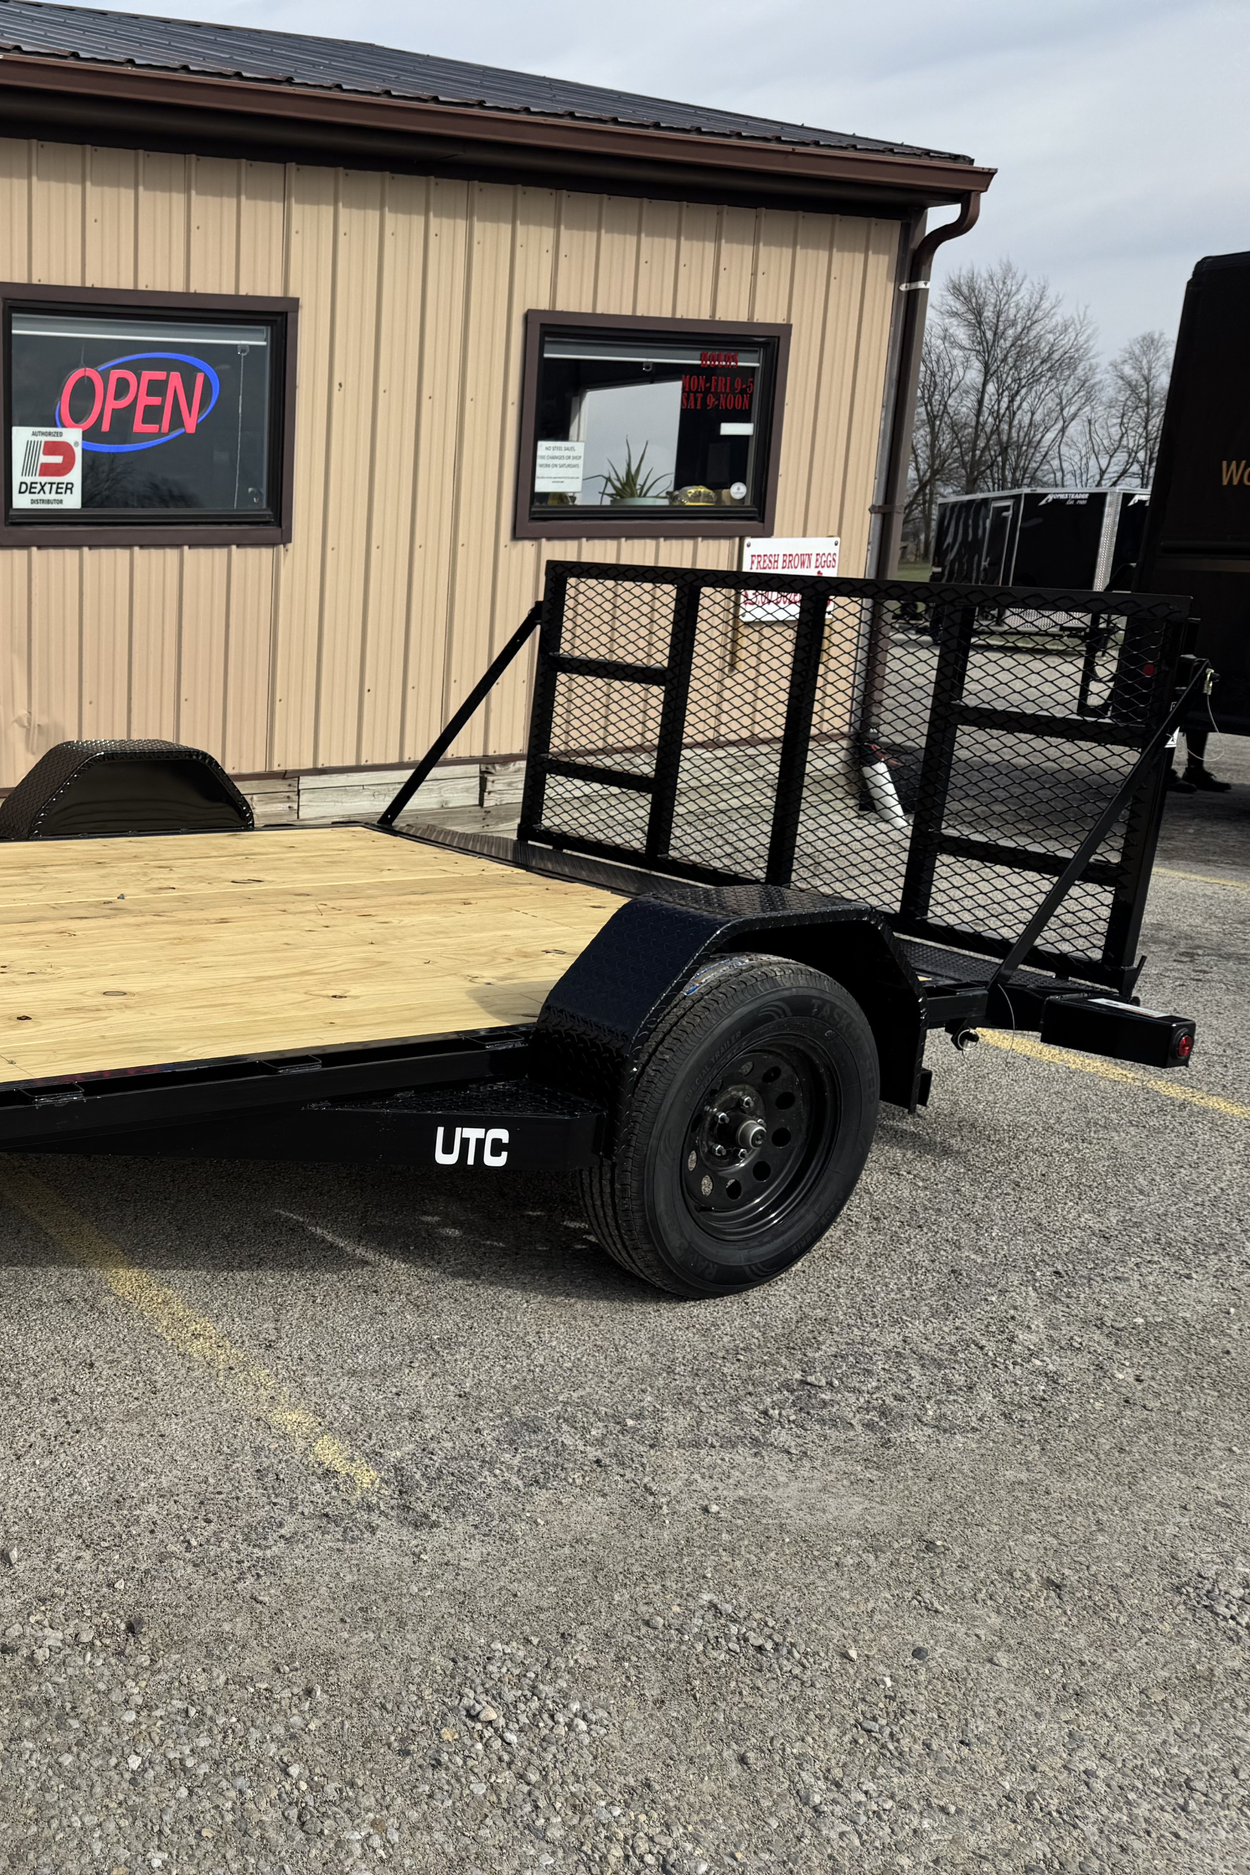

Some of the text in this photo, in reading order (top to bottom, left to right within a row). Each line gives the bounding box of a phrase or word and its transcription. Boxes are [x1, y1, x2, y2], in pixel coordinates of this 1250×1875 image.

[700, 351, 739, 368] HOURS
[681, 375, 754, 394] MON-FRI 9-5
[60, 367, 205, 434] OPEN
[681, 393, 751, 410] SAT 9-NOON
[31, 430, 64, 438] AUTHORIZED
[18, 481, 75, 495] DEXTER
[30, 498, 64, 506] DISTRIBUTOR
[749, 552, 837, 570] FRESH BROWN EGGS
[435, 1126, 510, 1167] UTC
